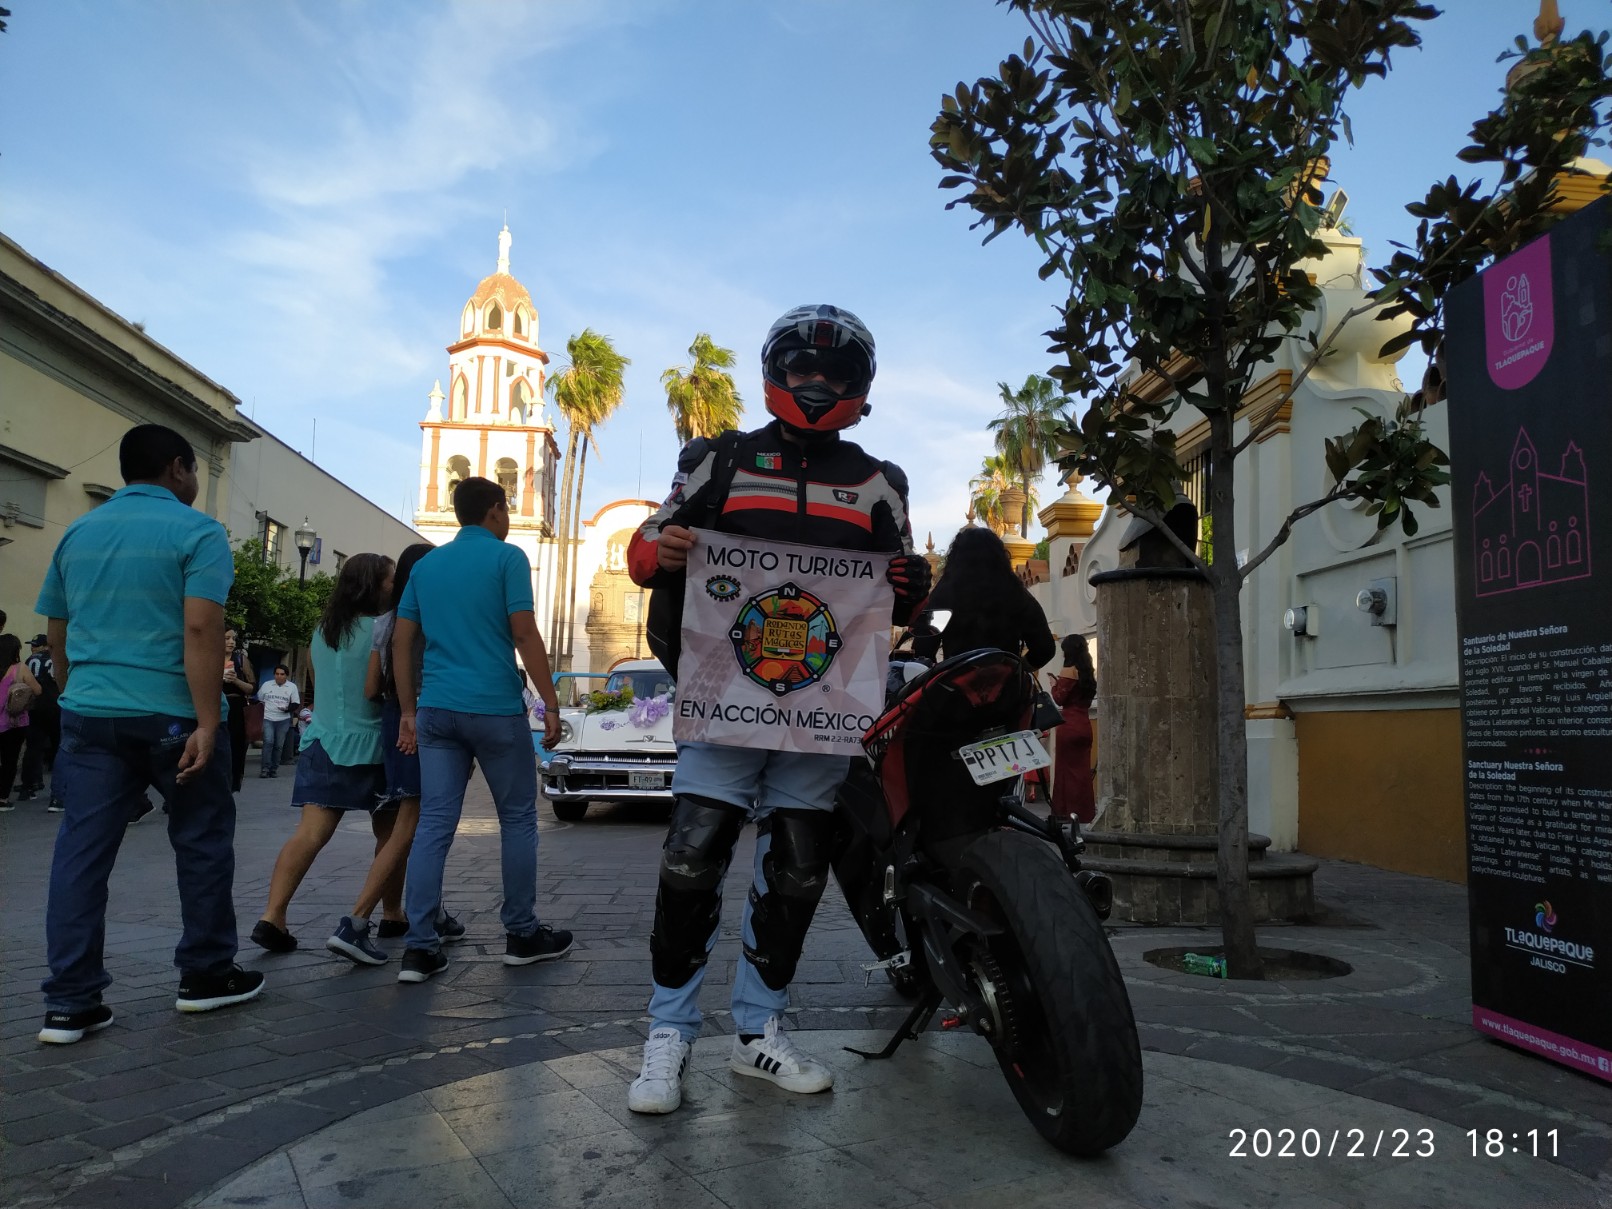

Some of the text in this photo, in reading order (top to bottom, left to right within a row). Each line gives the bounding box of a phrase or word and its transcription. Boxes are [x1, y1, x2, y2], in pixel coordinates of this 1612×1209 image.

[1495, 340, 1544, 370] TLAQUEPAQUE
[706, 545, 874, 579] MOTO TURISTA
[784, 586, 796, 597] N
[731, 630, 743, 639] O
[1464, 625, 1567, 645] Santuario de Nuestra Señora
[828, 639, 838, 648] E
[1464, 642, 1510, 655] de la Soledad
[775, 682, 786, 692] S
[680, 700, 874, 732] EN ACCIÓN MÉXICO
[814, 734, 830, 742] RRM
[1468, 760, 1563, 771] Sanctuary Nuestra Señora
[1469, 771, 1516, 780] de la Soledad
[1530, 956, 1566, 975] JALISCO
[1482, 1018, 1596, 1066] www.tlaquepaque.gob.mx
